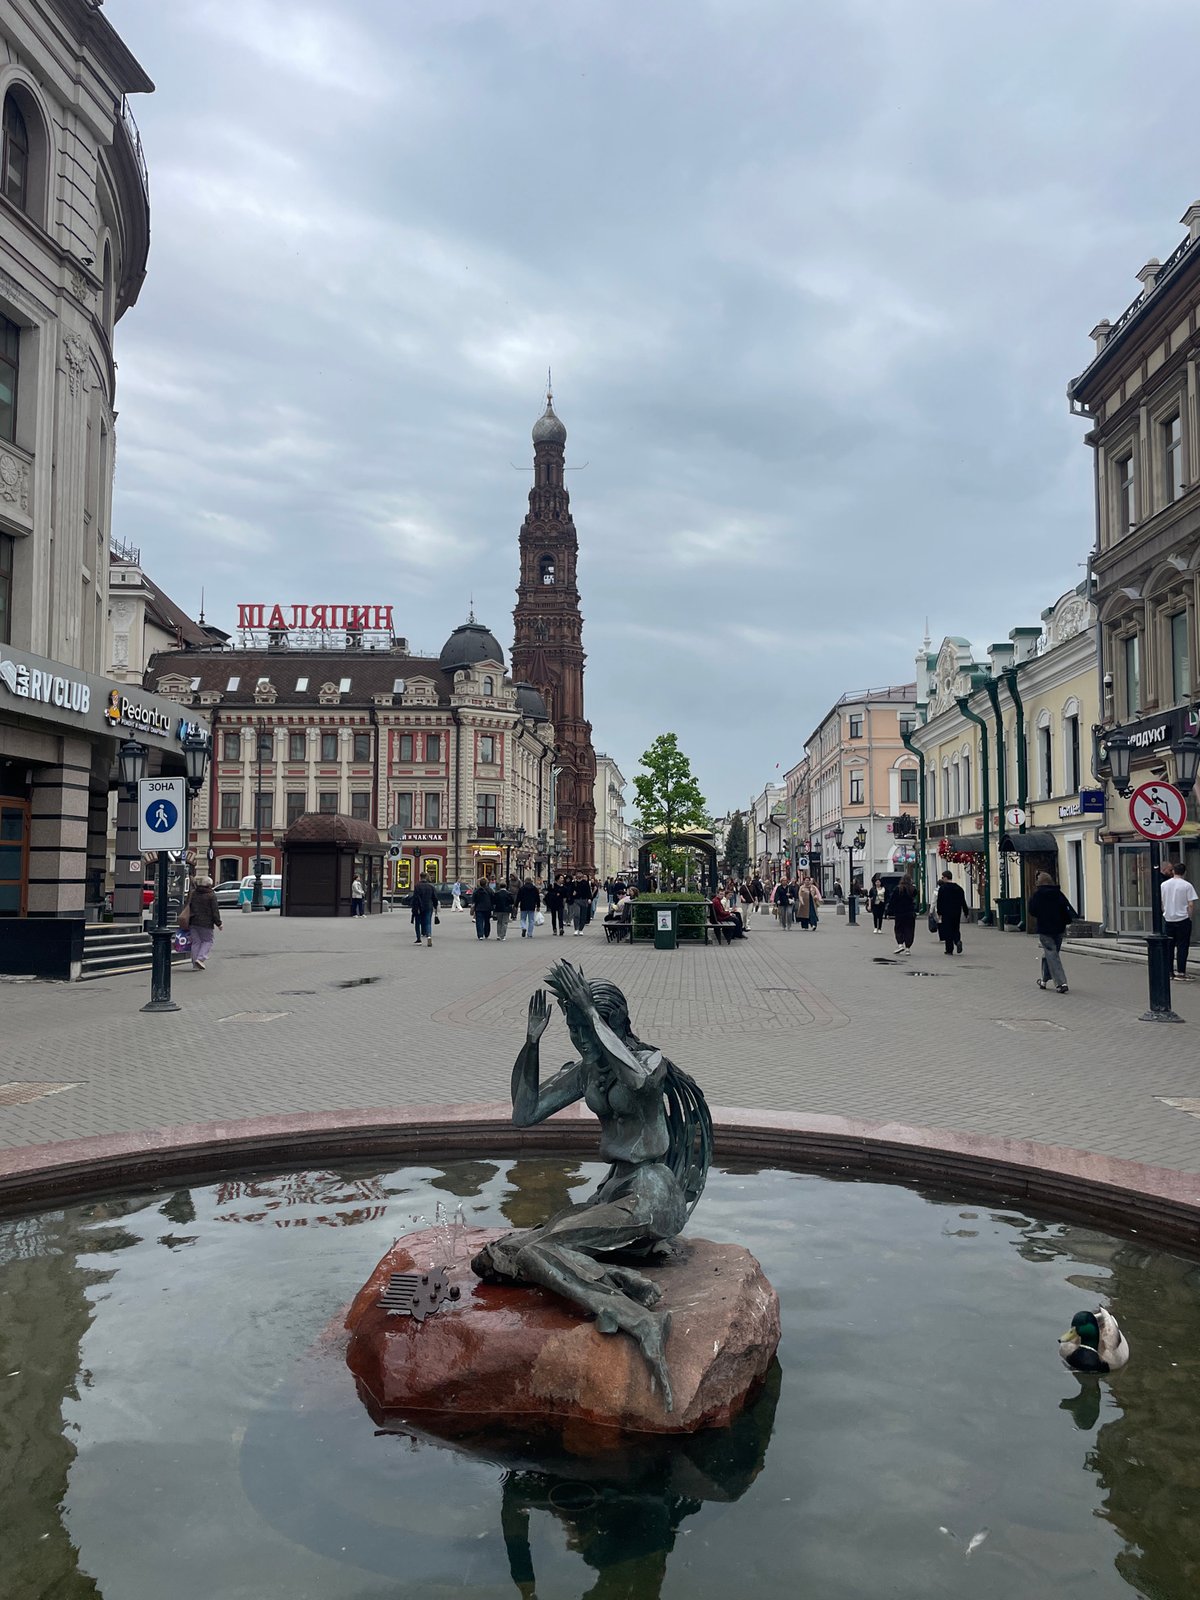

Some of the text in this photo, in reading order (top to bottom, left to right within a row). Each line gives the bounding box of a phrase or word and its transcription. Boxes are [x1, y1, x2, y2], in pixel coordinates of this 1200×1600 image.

[237, 603, 394, 629] ШАЛЯПИН
[16, 664, 30, 697] БАР
[121, 697, 171, 730] Pedant.ru
[148, 782, 175, 792] ЗОНА
